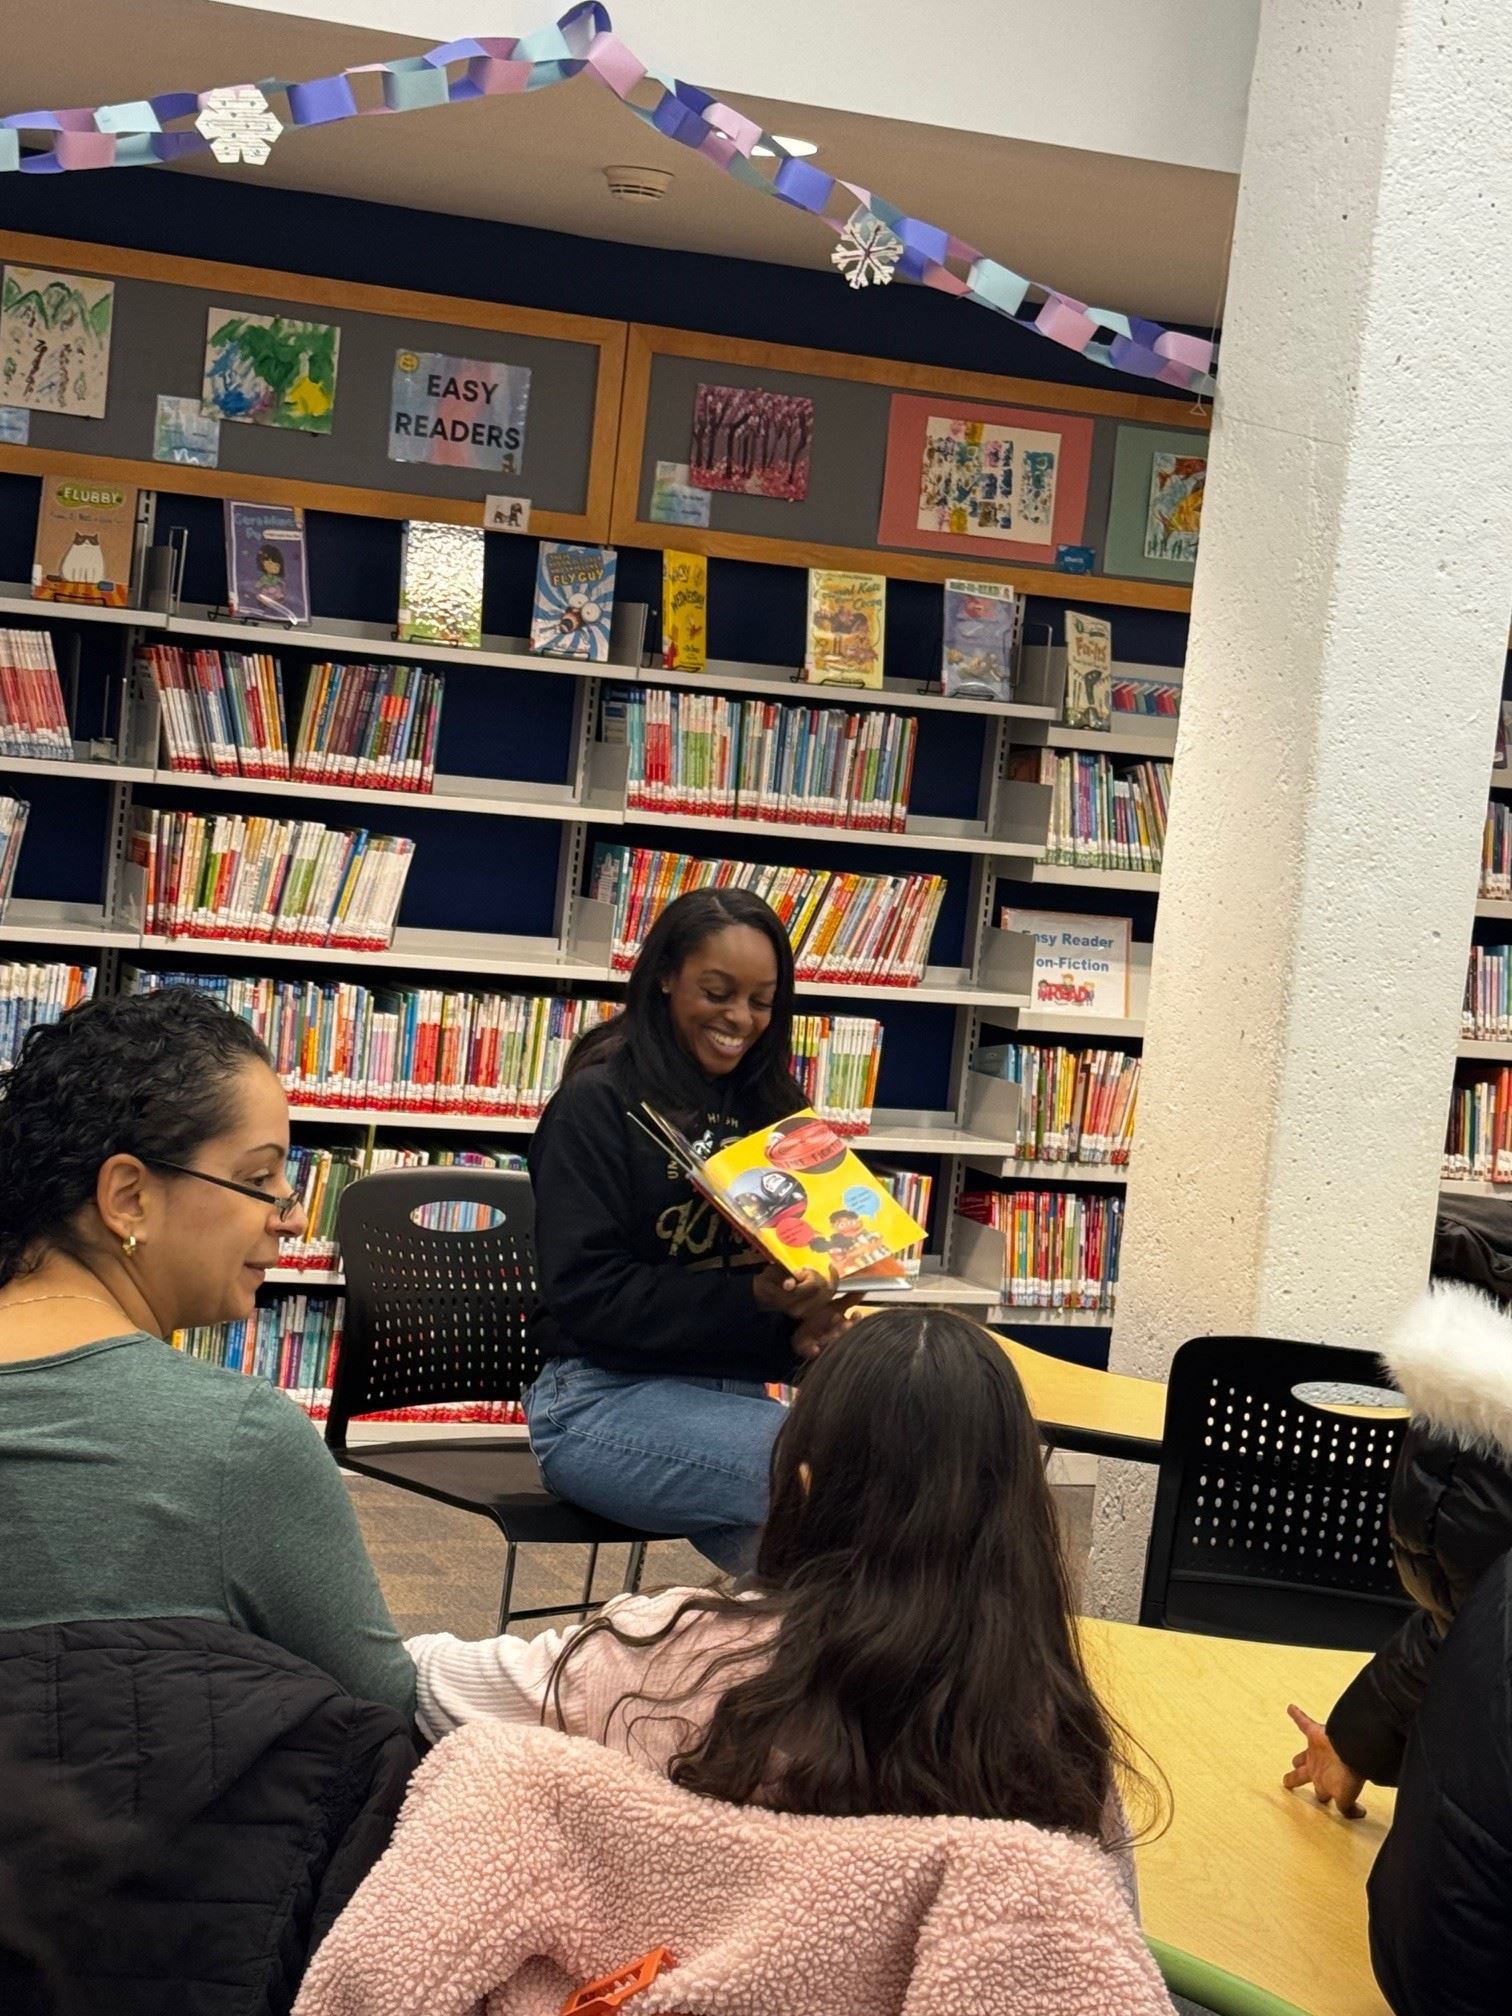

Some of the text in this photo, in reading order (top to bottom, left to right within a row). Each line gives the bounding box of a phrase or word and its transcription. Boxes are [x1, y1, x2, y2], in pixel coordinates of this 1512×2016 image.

[427, 374, 499, 404] EASY
[394, 412, 520, 450] READERS
[63, 487, 119, 504] FLUBBY
[551, 569, 604, 587] FLY GUY
[1022, 930, 1114, 948] asy Reader
[1036, 957, 1109, 972] on-Fiction
